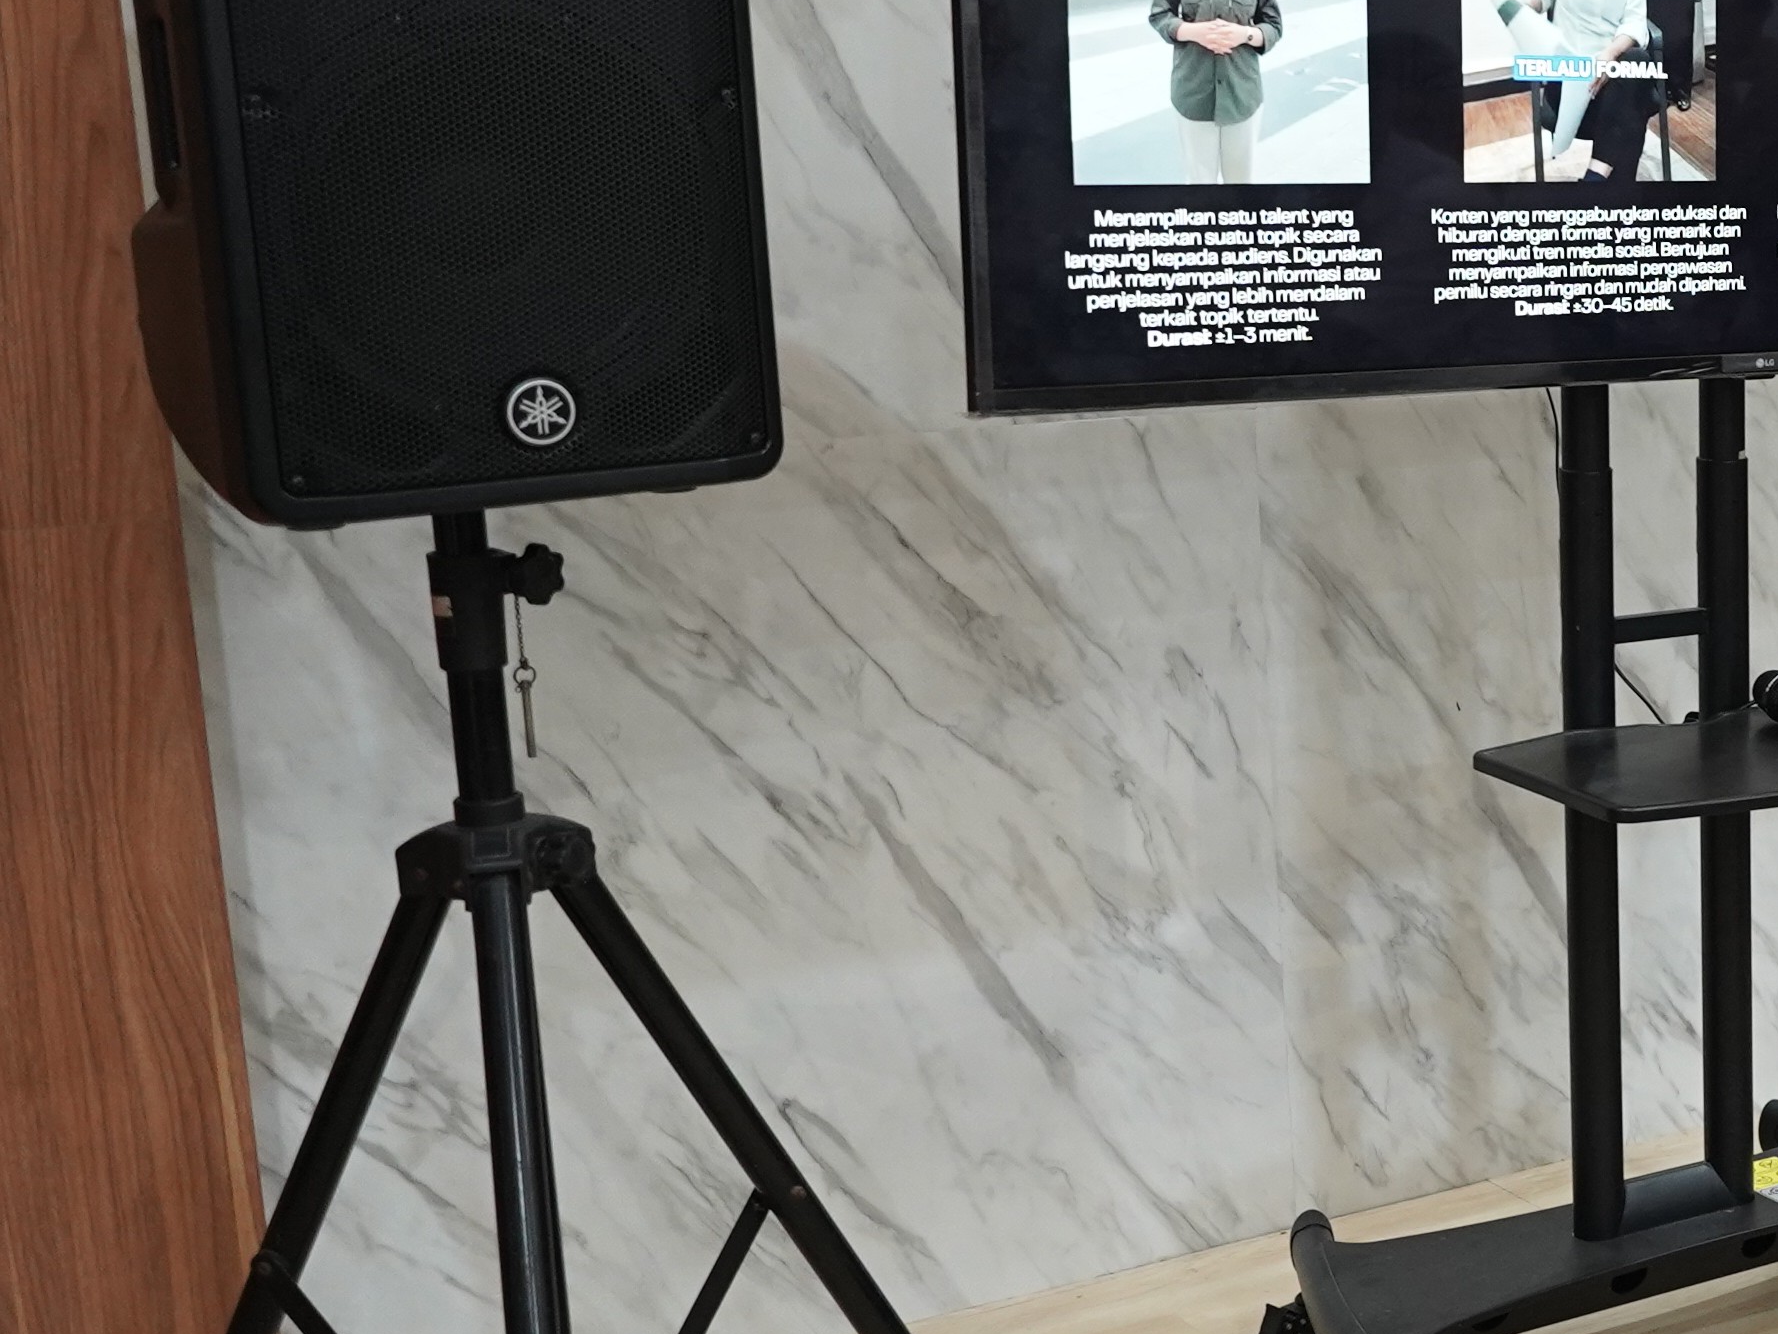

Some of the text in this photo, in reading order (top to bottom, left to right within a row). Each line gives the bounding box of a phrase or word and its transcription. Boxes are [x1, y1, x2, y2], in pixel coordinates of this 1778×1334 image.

[1516, 58, 1668, 79] TERLALU FORMAL
[1094, 208, 1354, 229] Menampilkan satu talent yang
[1431, 204, 1747, 226] Konten yang menggabungkan edukasi dan
[1089, 228, 1360, 251] menjelaskan suatu topik secara
[1438, 223, 1741, 246] hiburan dengan format yang menarik dan
[1065, 250, 1150, 272] langsung
[1152, 249, 1218, 270] kepada
[1293, 246, 1383, 266] Digunakan
[1452, 243, 1531, 265] mengikuti
[1533, 244, 1564, 260] tren
[1567, 243, 1614, 259] media
[1661, 241, 1729, 259] Bertujuan
[1068, 266, 1381, 290] untuk menyampaikan informasi atau
[1448, 260, 1732, 284] menyampaikan informasi pengawasan
[1086, 285, 1366, 313] penjelasan yang lebih mendalam
[1434, 283, 1488, 304] pemilu
[1490, 285, 1542, 298] secara
[1544, 280, 1592, 300] ringan
[1594, 280, 1623, 296] dan
[1625, 278, 1676, 295] mudah
[1139, 309, 1198, 327] terkait
[1200, 307, 1245, 327] topik
